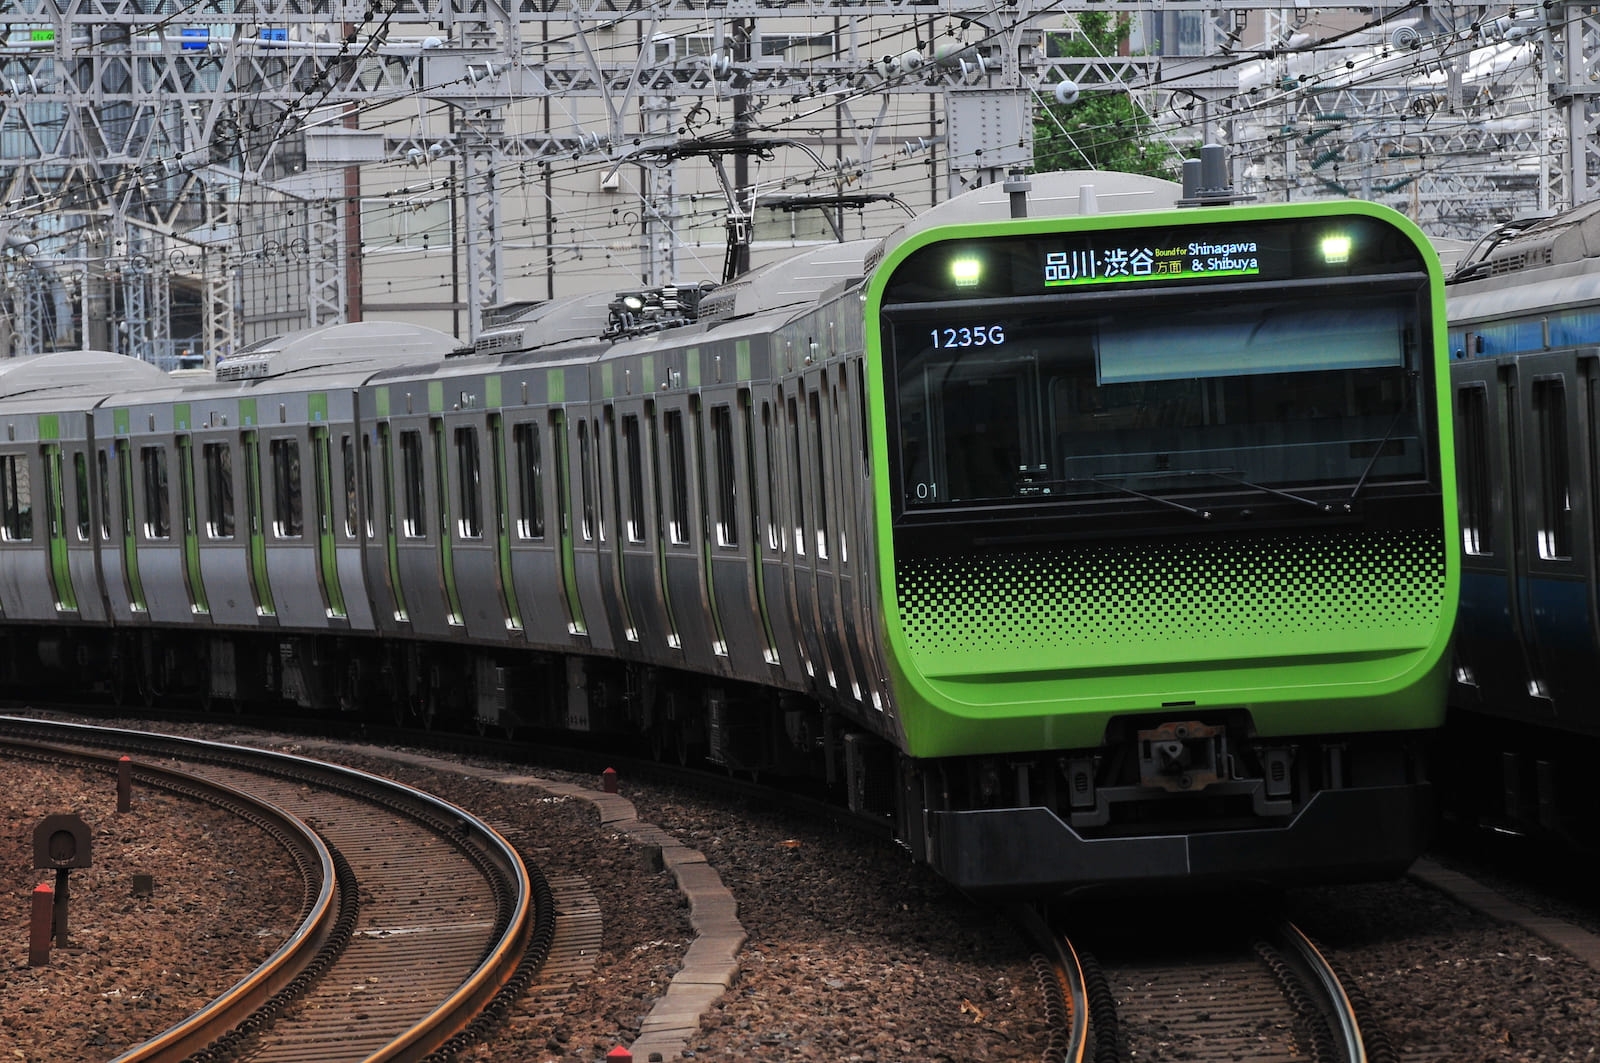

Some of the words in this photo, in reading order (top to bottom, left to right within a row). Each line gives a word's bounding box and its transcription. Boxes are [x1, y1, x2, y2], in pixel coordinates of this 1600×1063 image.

[1155, 248, 1176, 257] Bound
[1176, 247, 1187, 256] for
[1188, 242, 1257, 256] Shinagawa
[1155, 260, 1182, 274] 方面
[1192, 260, 1204, 271] &
[1208, 257, 1258, 272] Shibuya
[930, 325, 1005, 348] 1235G
[916, 482, 937, 498] 01
